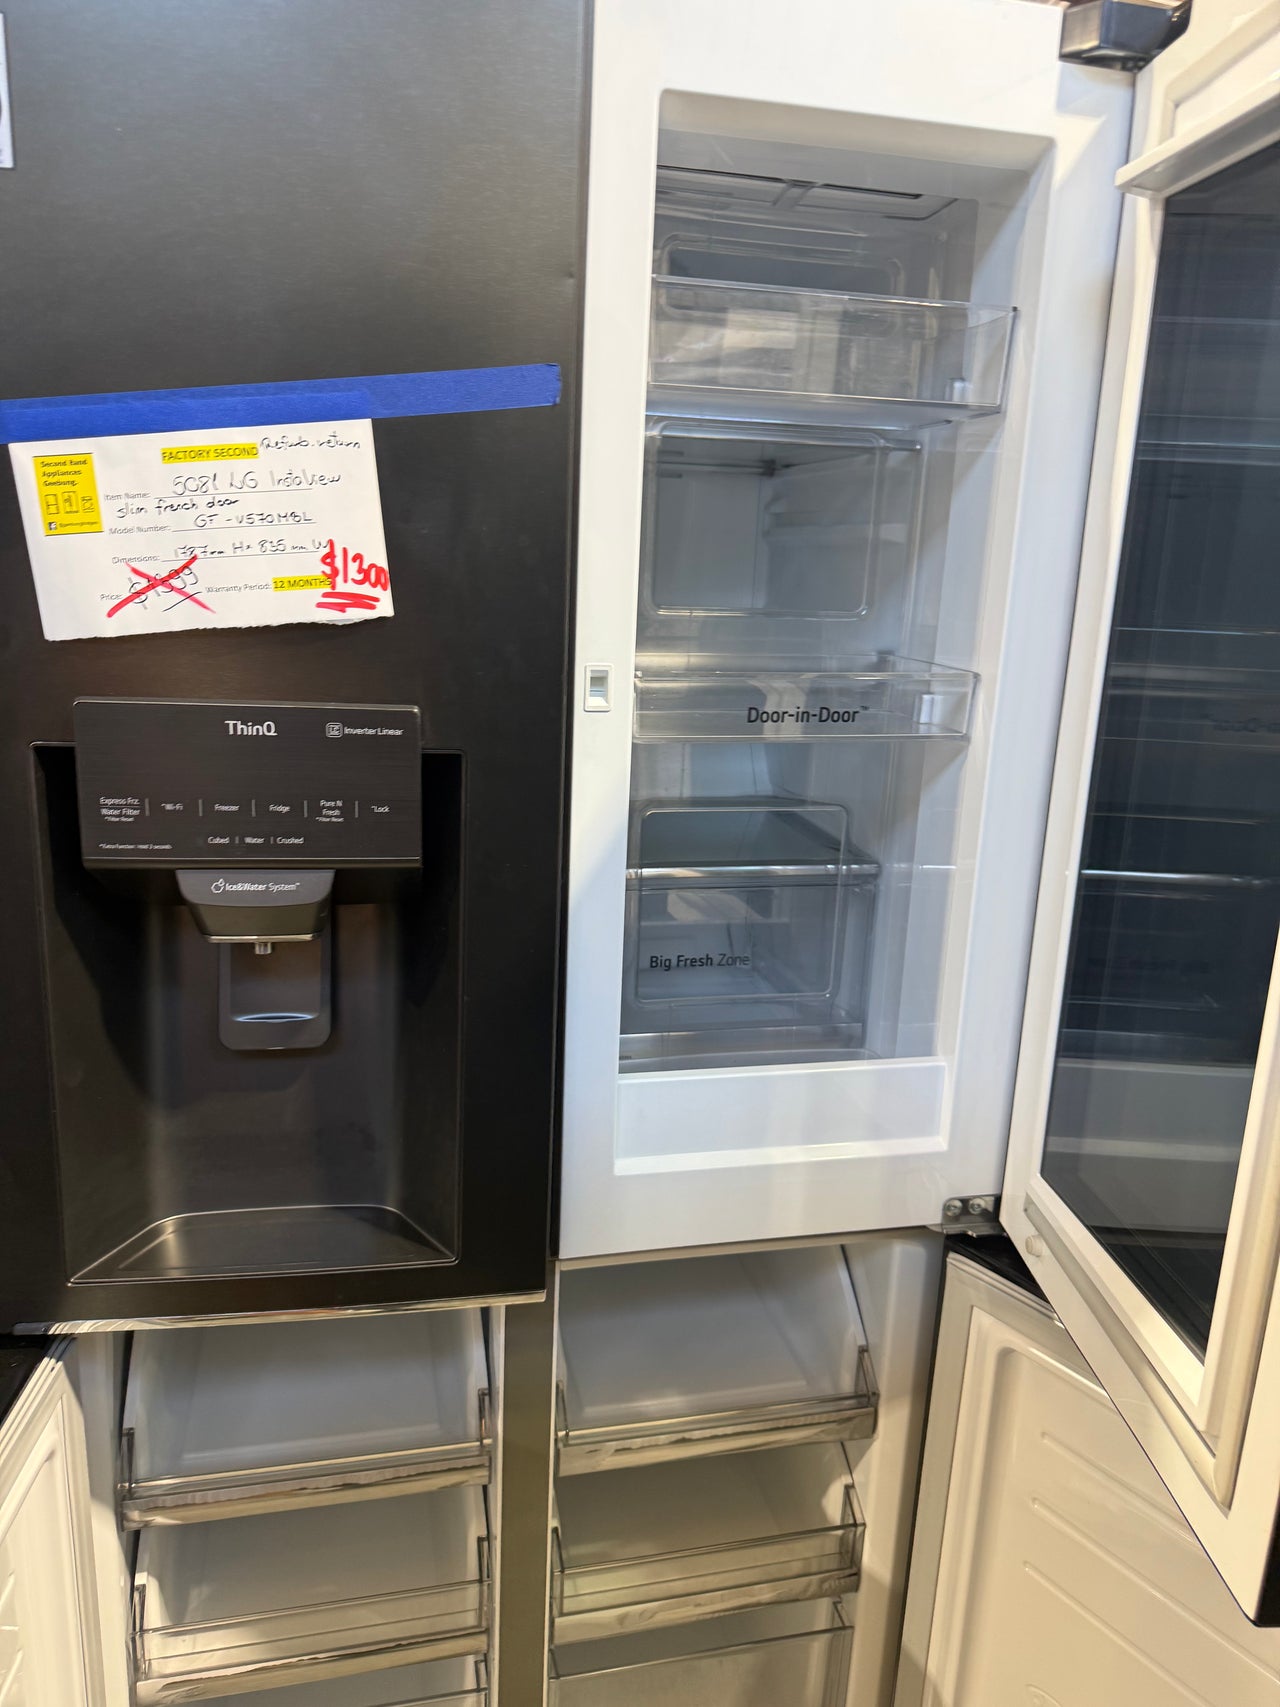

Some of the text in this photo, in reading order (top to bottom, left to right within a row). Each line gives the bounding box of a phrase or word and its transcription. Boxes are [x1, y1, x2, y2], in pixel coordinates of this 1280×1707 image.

[162, 446, 259, 462] FACTORY SECOND
[117, 502, 148, 519] slim
[112, 555, 160, 564] Dimensions:
[320, 539, 390, 591] $1300
[205, 584, 243, 593] Warranty
[273, 579, 286, 589] 12
[287, 577, 333, 588] MONTHS
[224, 720, 278, 736] ThinQ
[214, 803, 240, 811] Freezer
[269, 804, 291, 813] Fridge
[322, 808, 341, 816] Fresh
[207, 836, 231, 844] Cubed
[243, 836, 265, 844] Water
[276, 836, 305, 844] Crushed
[650, 953, 750, 972] Big Fresh Zone
